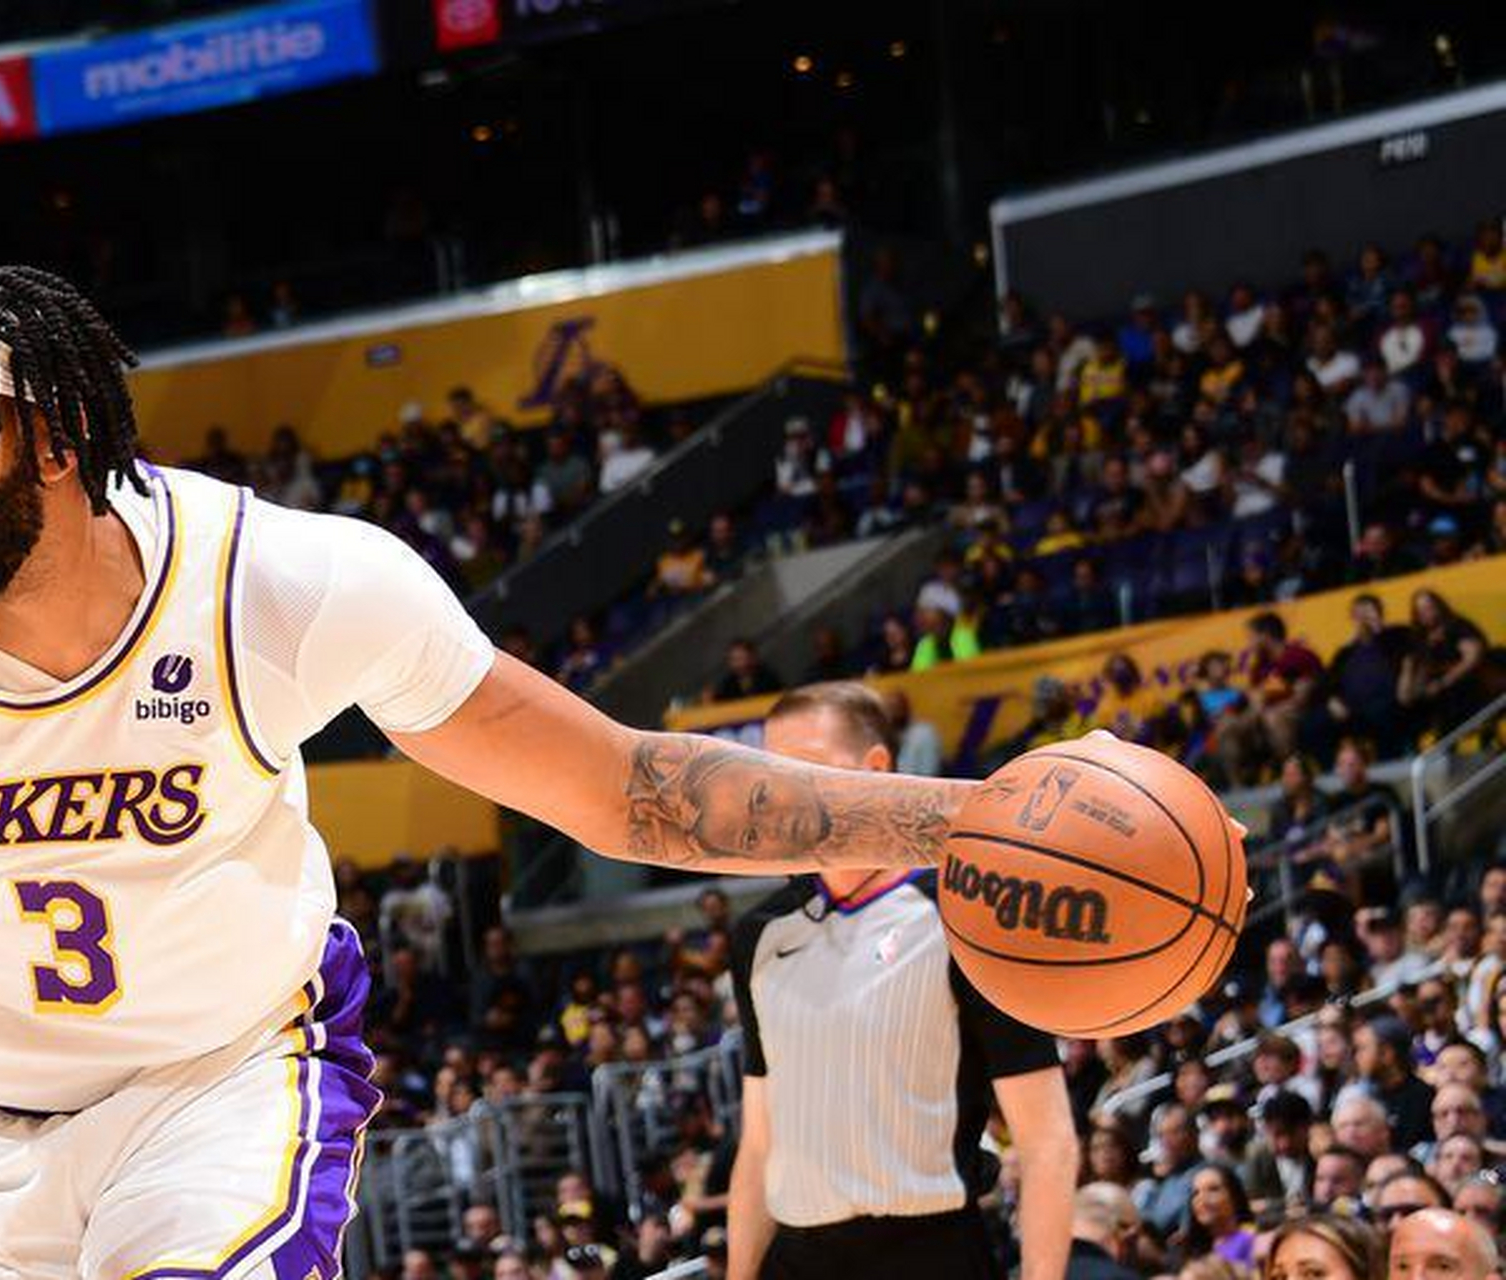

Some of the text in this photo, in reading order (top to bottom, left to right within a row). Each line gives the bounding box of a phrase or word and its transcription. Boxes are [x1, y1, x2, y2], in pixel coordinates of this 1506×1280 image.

[85, 22, 323, 99] mobilitie
[135, 697, 210, 724] bibigo
[944, 852, 1111, 944] Wilson
[9, 878, 122, 1014] 3
